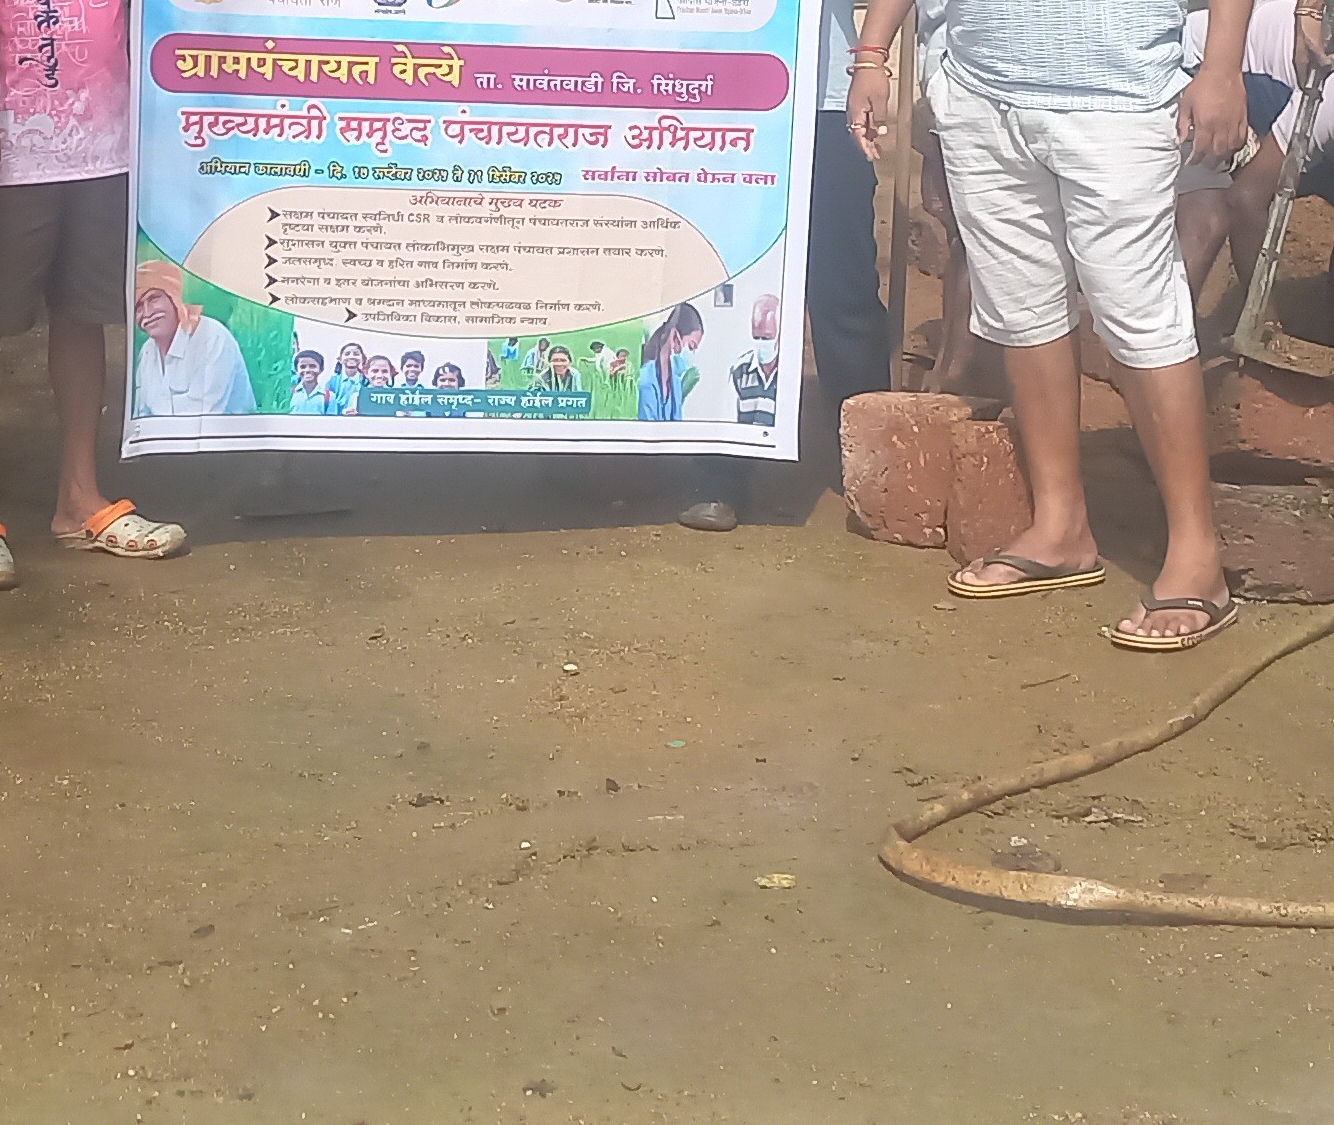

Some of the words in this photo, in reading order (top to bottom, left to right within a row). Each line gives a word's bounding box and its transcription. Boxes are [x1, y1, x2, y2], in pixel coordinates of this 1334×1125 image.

[175, 39, 380, 84] ग्रामपंचायत
[391, 44, 465, 88] वेत्ये
[474, 72, 503, 89] ता.
[511, 68, 603, 93] सावंतवाडी
[611, 71, 643, 94] जि.
[651, 73, 713, 102] सिंधुदुर्ग
[181, 103, 327, 147] मुख्यमंत्री
[443, 108, 612, 150] पंचायतराज
[624, 114, 755, 153] अभियान
[199, 157, 251, 175] अभियान
[253, 160, 311, 177] कालावधी
[328, 161, 347, 180] दि.
[417, 167, 448, 182] २०२५
[452, 165, 464, 182] ते
[467, 169, 483, 184] ३१
[487, 166, 527, 185] डिसेंबर
[531, 170, 562, 186] २०२५
[644, 168, 689, 184] सोबत
[743, 173, 777, 186] चला
[409, 190, 485, 207] अभियानाचे
[528, 198, 564, 209] घटक
[282, 210, 314, 220] सक्षम
[318, 208, 358, 221] पंचायत
[407, 213, 430, 223] CSR
[436, 215, 445, 223] व
[529, 215, 590, 228] पंचायतराज
[640, 218, 682, 230] आर्थिक
[318, 224, 350, 233] सक्षम
[279, 238, 325, 252] सुशासन
[361, 237, 402, 251] पंचायत
[405, 240, 475, 256] लोकाभिमुख
[478, 244, 510, 255] सक्षम
[513, 242, 553, 255] पंचायत
[603, 247, 632, 257] तयार
[342, 258, 373, 268] स्वच्छ
[376, 259, 385, 268] व
[388, 257, 414, 269] हरित
[324, 277, 332, 286] व
[335, 278, 357, 288] इतर
[414, 278, 464, 290] अभिसरण
[465, 314, 516, 324] सामाजिक
[371, 392, 395, 404] गाव
[399, 390, 432, 406] होईल
[487, 395, 516, 407] राज्य
[521, 393, 552, 408] होईल
[558, 397, 588, 409] प्रगत
